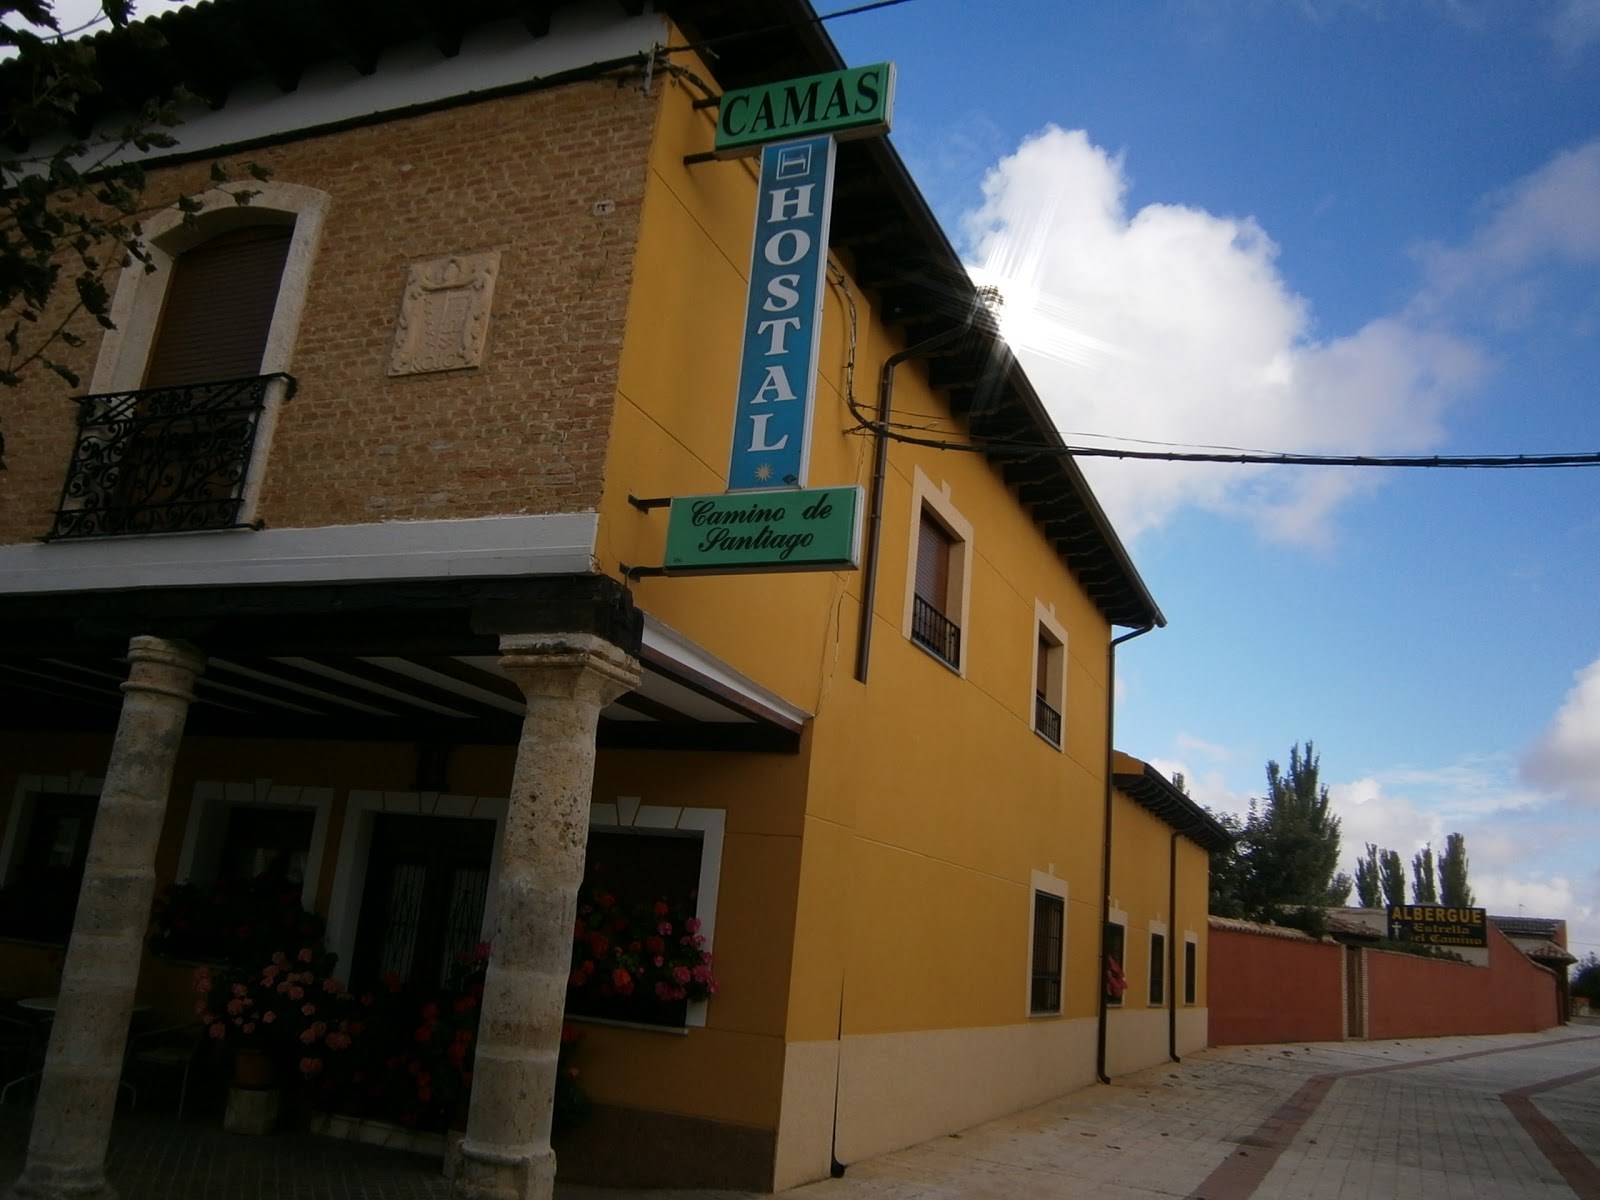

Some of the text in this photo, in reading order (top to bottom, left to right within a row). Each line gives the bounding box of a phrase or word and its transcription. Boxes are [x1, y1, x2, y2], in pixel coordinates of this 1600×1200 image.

[722, 71, 880, 137] CAMAS
[747, 183, 816, 452] HOSTAL
[691, 493, 833, 526] Camino de
[698, 525, 814, 561] Santiago
[1392, 906, 1482, 924] ALBERGUE
[1413, 922, 1470, 935] Estrella
[1429, 934, 1482, 945] Camino
